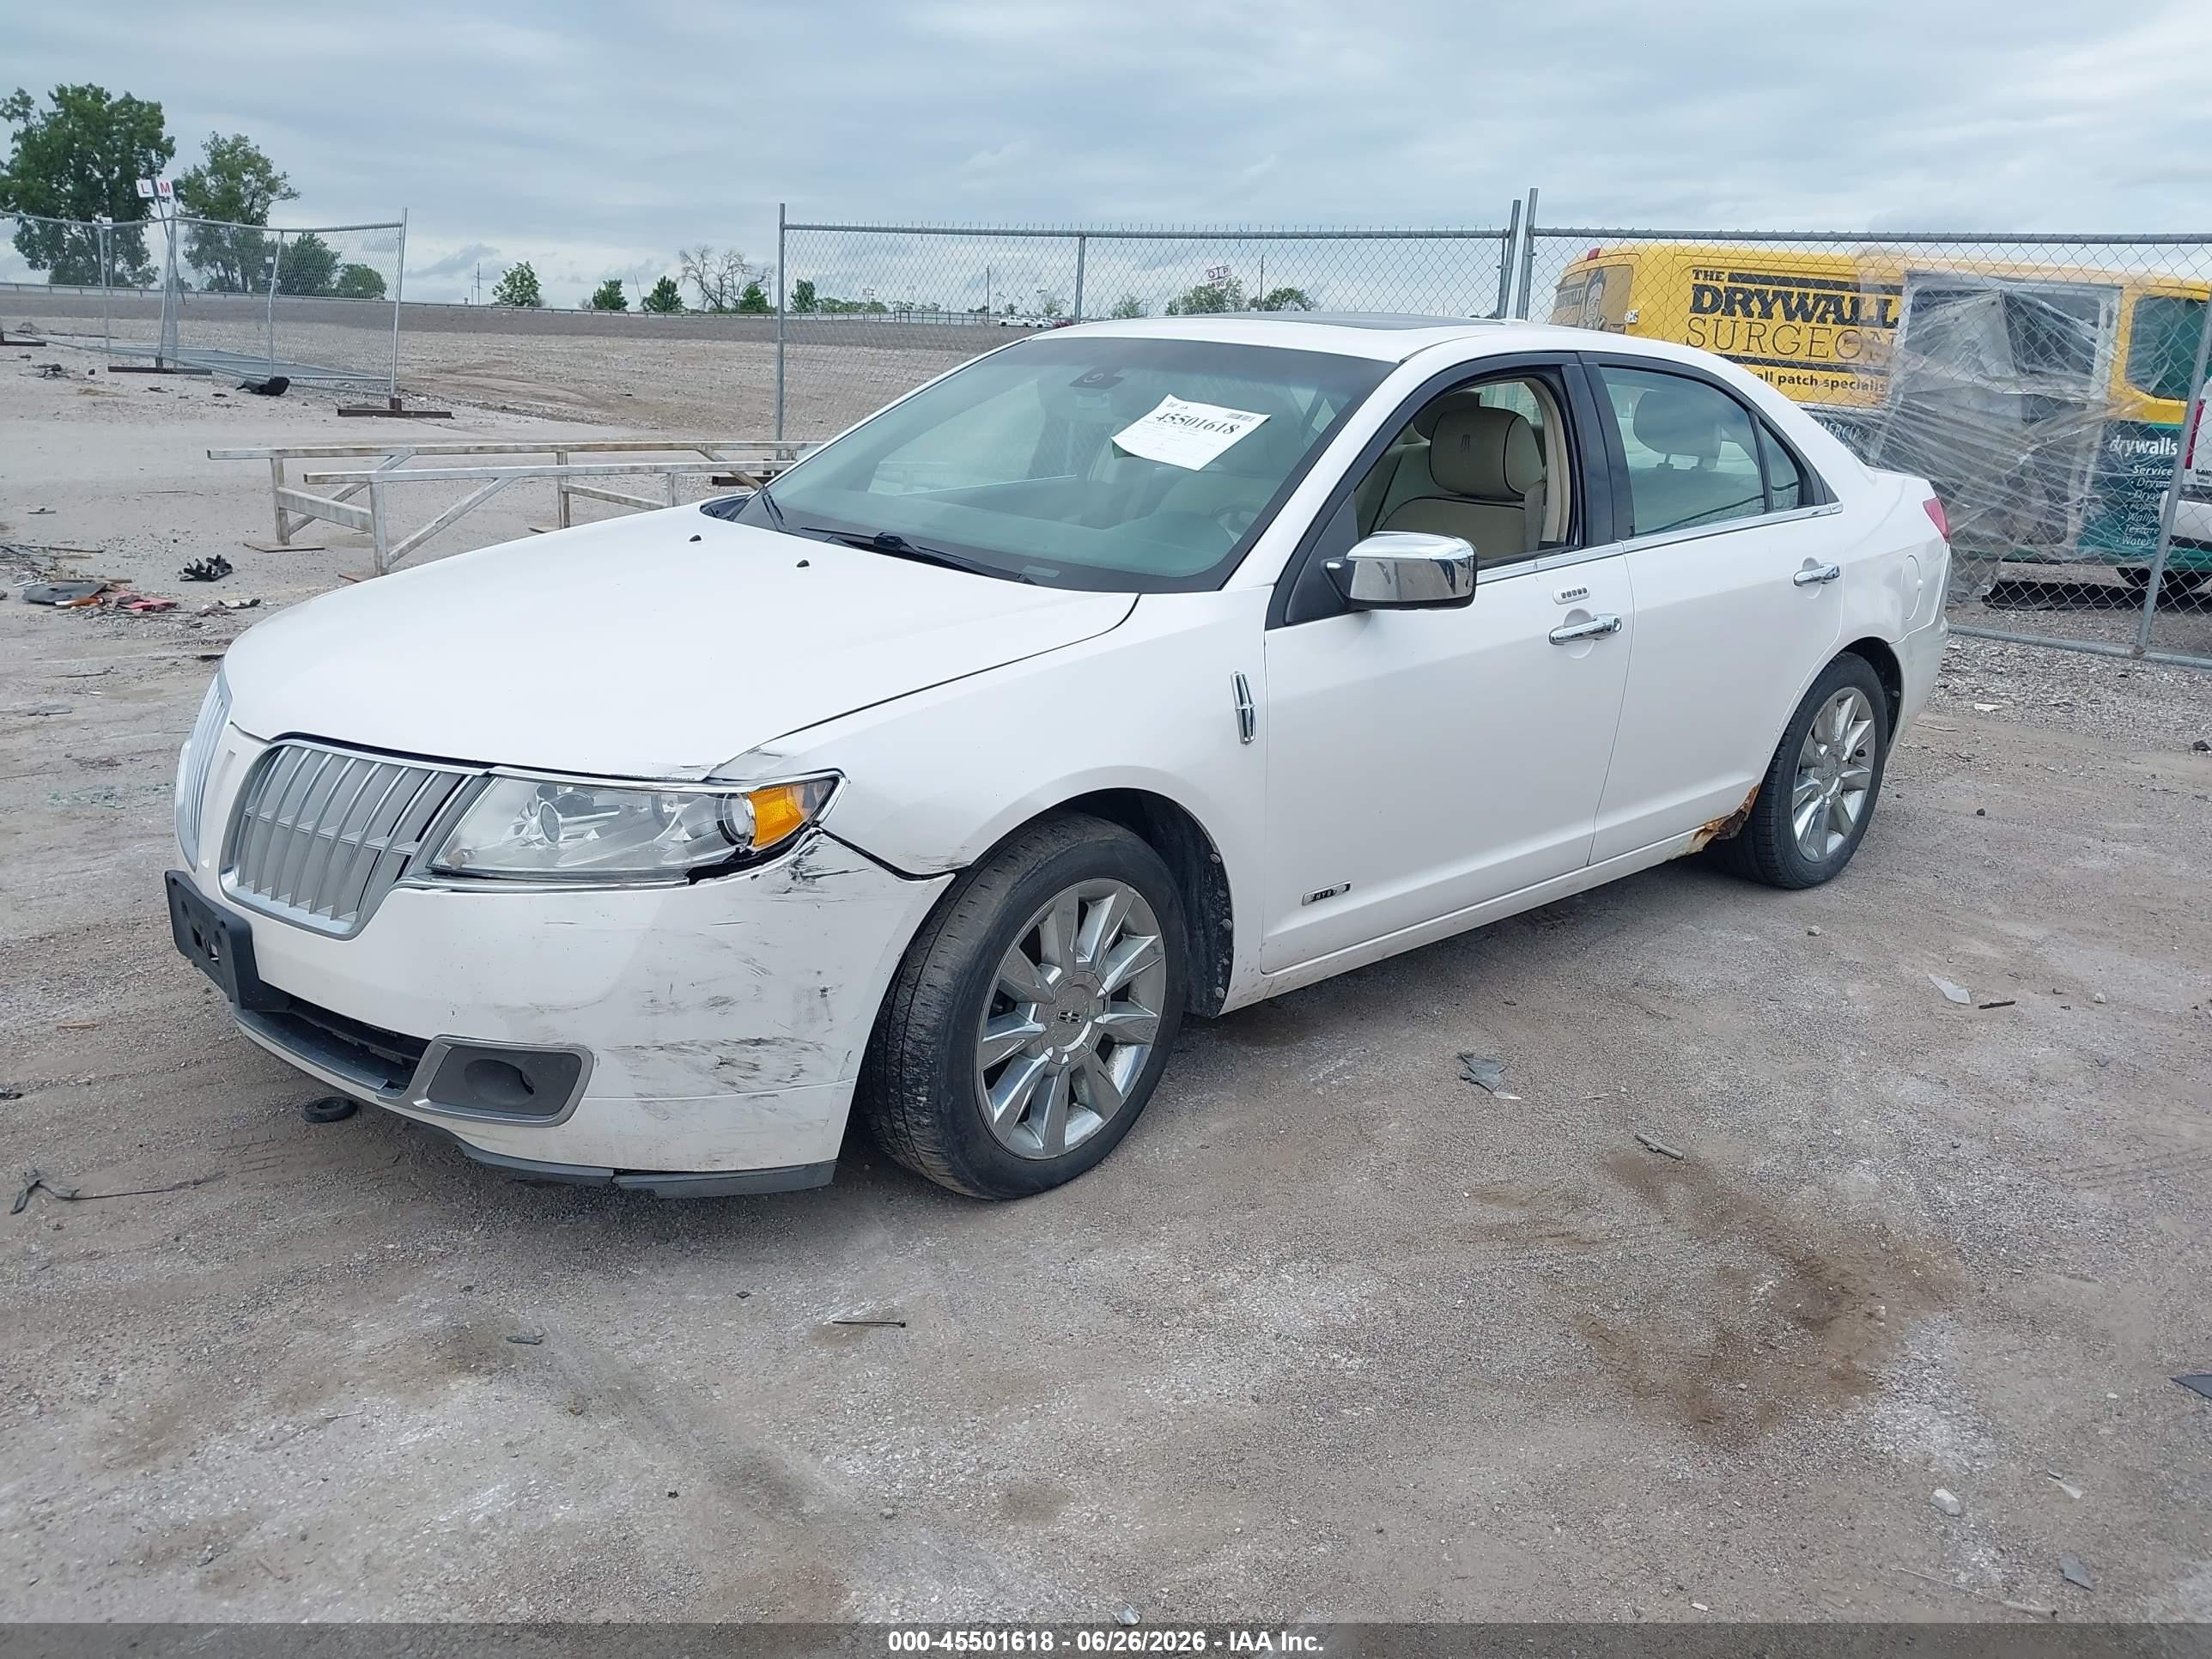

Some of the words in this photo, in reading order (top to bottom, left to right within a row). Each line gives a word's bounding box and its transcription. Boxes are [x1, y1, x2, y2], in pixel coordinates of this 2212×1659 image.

[141, 183, 150, 194] L
[160, 182, 171, 193] M
[1692, 269, 1725, 283] THE
[1690, 283, 1899, 329] DRYWALL
[1755, 370, 1773, 383] all
[1778, 373, 1819, 387] patch
[1823, 379, 1887, 392] specialis
[1155, 412, 1241, 434] 45501618
[2132, 465, 2174, 476] Service
